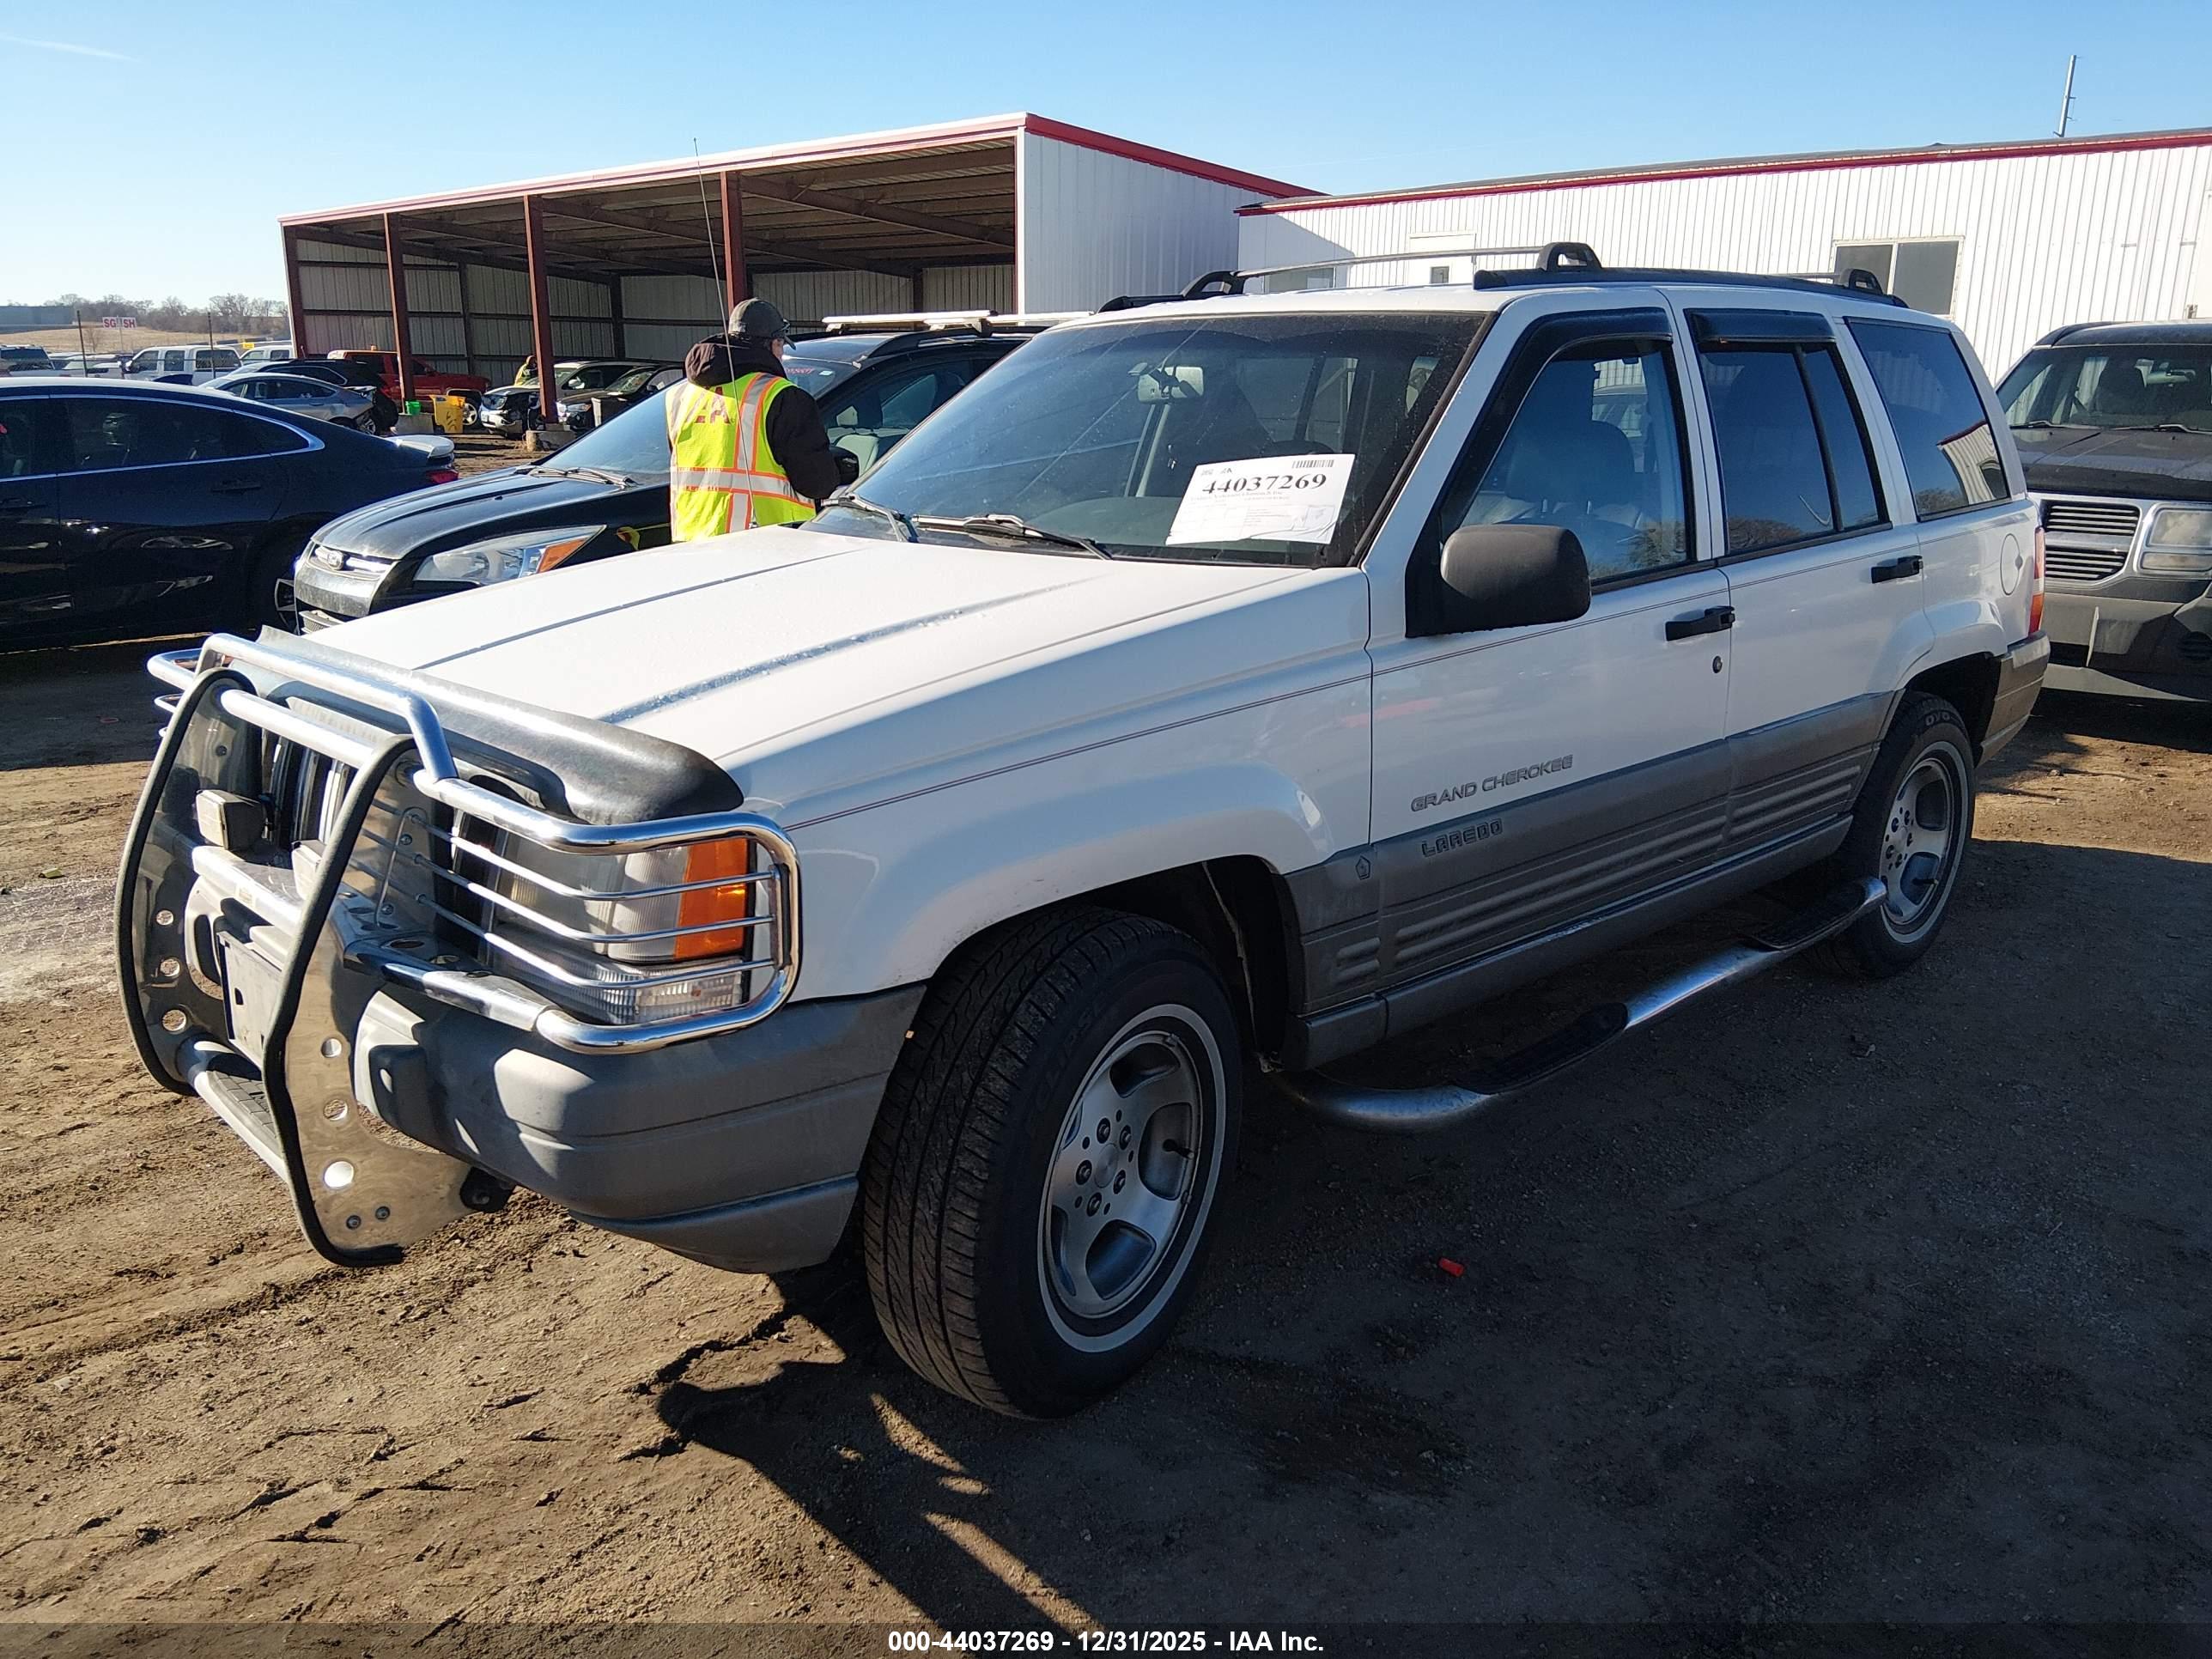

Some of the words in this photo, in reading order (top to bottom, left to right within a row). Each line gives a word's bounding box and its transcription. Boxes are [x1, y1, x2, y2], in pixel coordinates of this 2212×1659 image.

[1201, 473, 1328, 495] 44037269
[1410, 781, 1478, 812] GRAND
[1481, 754, 1574, 792] CHEROKEE
[1421, 817, 1503, 858] LAREDO
